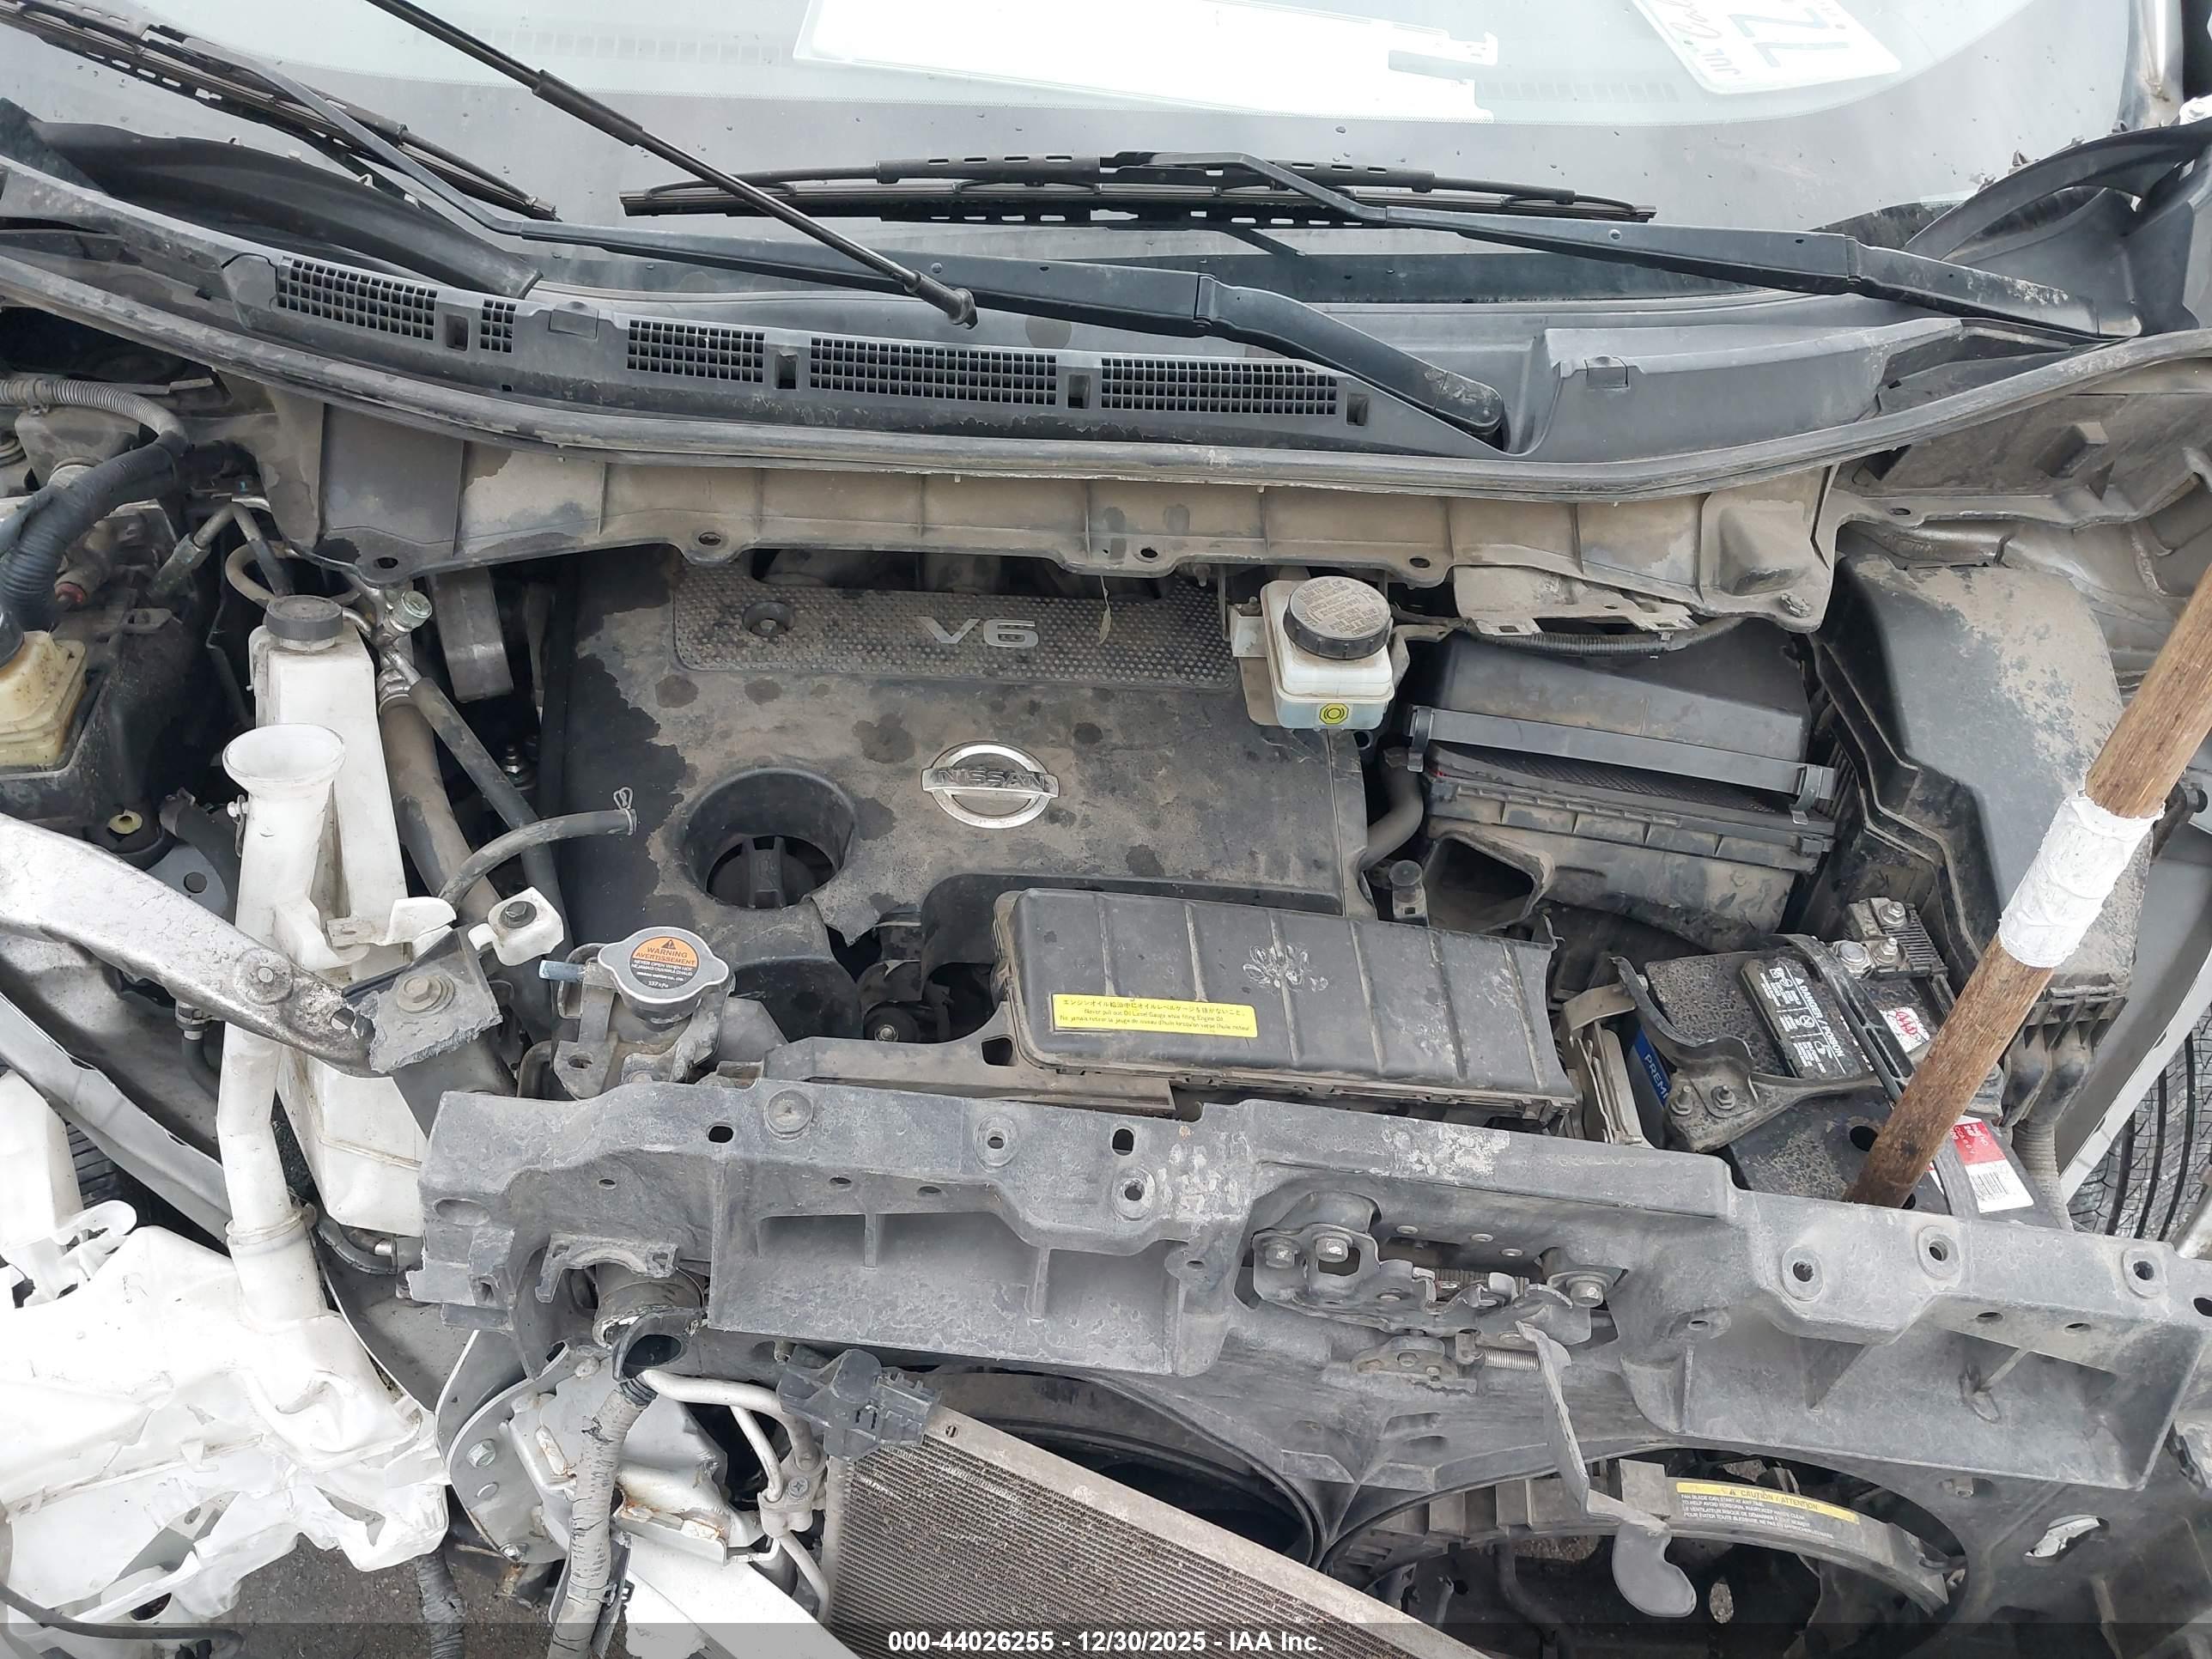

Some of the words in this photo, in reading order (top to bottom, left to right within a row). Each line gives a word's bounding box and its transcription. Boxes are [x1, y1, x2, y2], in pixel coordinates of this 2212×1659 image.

[1702, 48, 1741, 76] JUL
[915, 616, 1039, 647] V6
[937, 769, 1046, 789] NISSAN
[635, 952, 696, 965] AVERTISSEMENT
[647, 946, 688, 958] WARNING
[1799, 985, 1824, 1019] DANGER
[1821, 1025, 1845, 1058] POISON
[1740, 1490, 1773, 1500] CAUTION
[1781, 1497, 1819, 1511] ATTENTION
